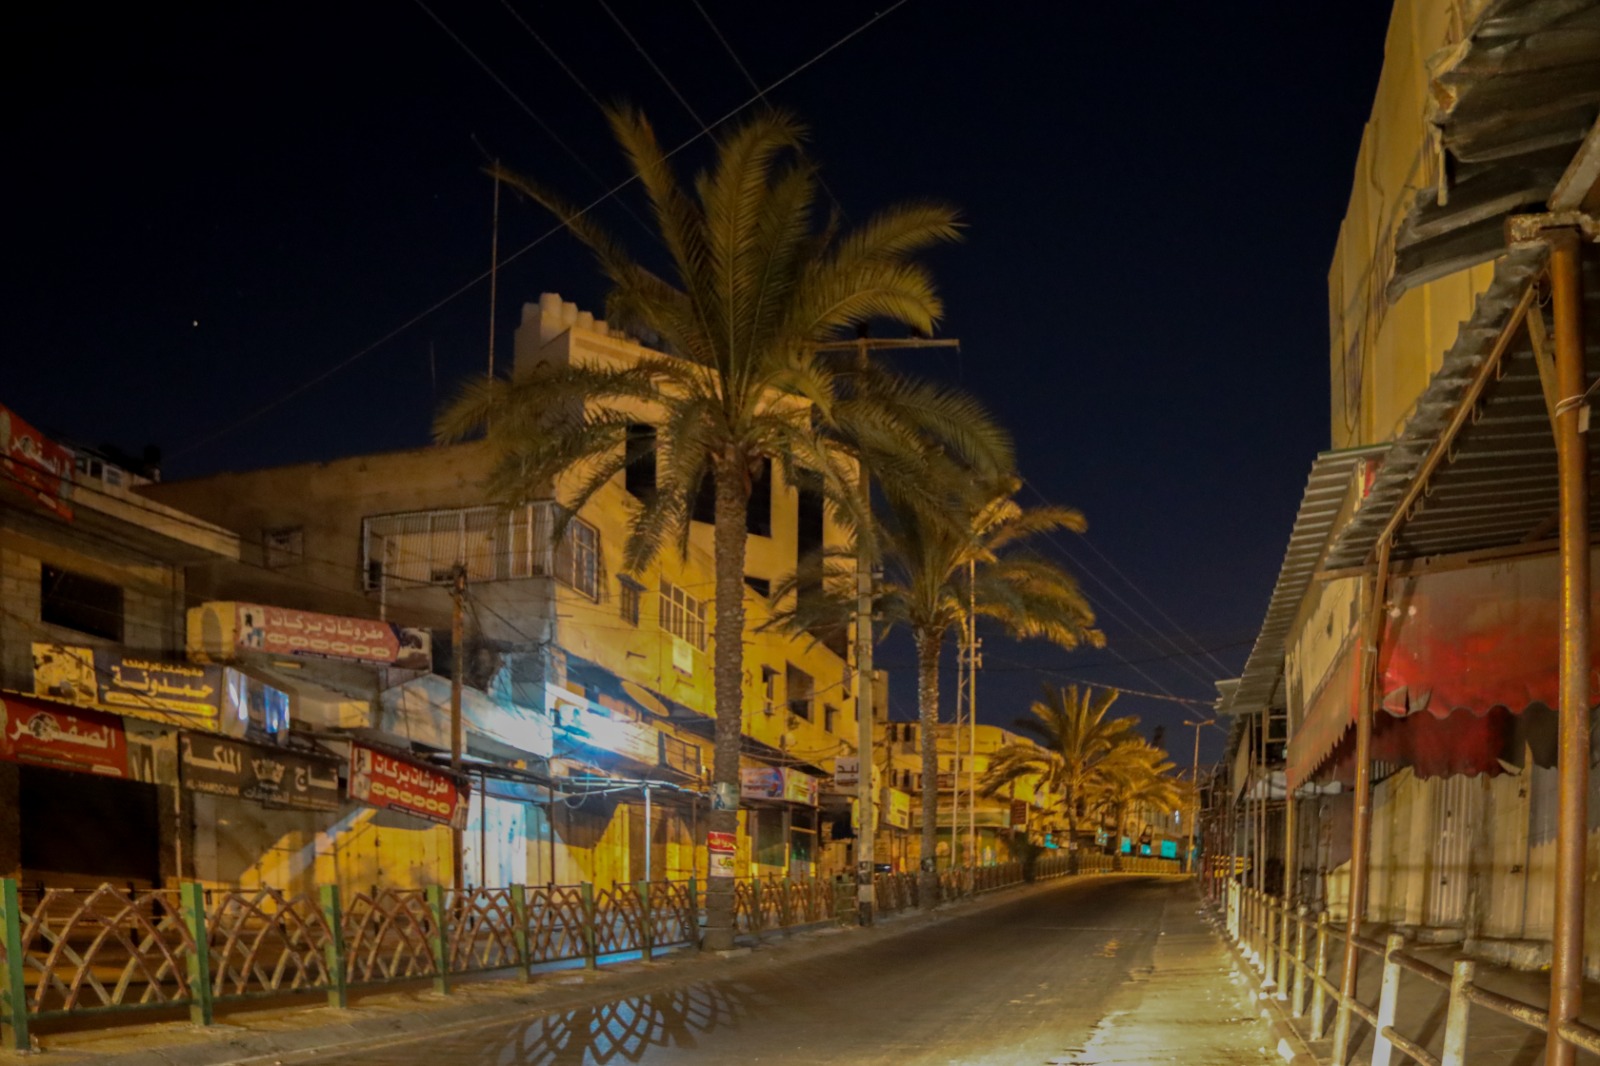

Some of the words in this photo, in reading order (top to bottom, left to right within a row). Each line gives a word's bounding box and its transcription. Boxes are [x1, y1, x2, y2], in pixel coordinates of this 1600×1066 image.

[270, 610, 322, 637] بركات
[324, 617, 384, 641] مفروشات
[111, 665, 214, 698] حمدونة
[9, 716, 116, 749] الصقر
[180, 736, 241, 774] الملكة
[294, 764, 339, 792] تاج
[374, 755, 410, 788] بركات
[410, 767, 449, 796] مفروشات
